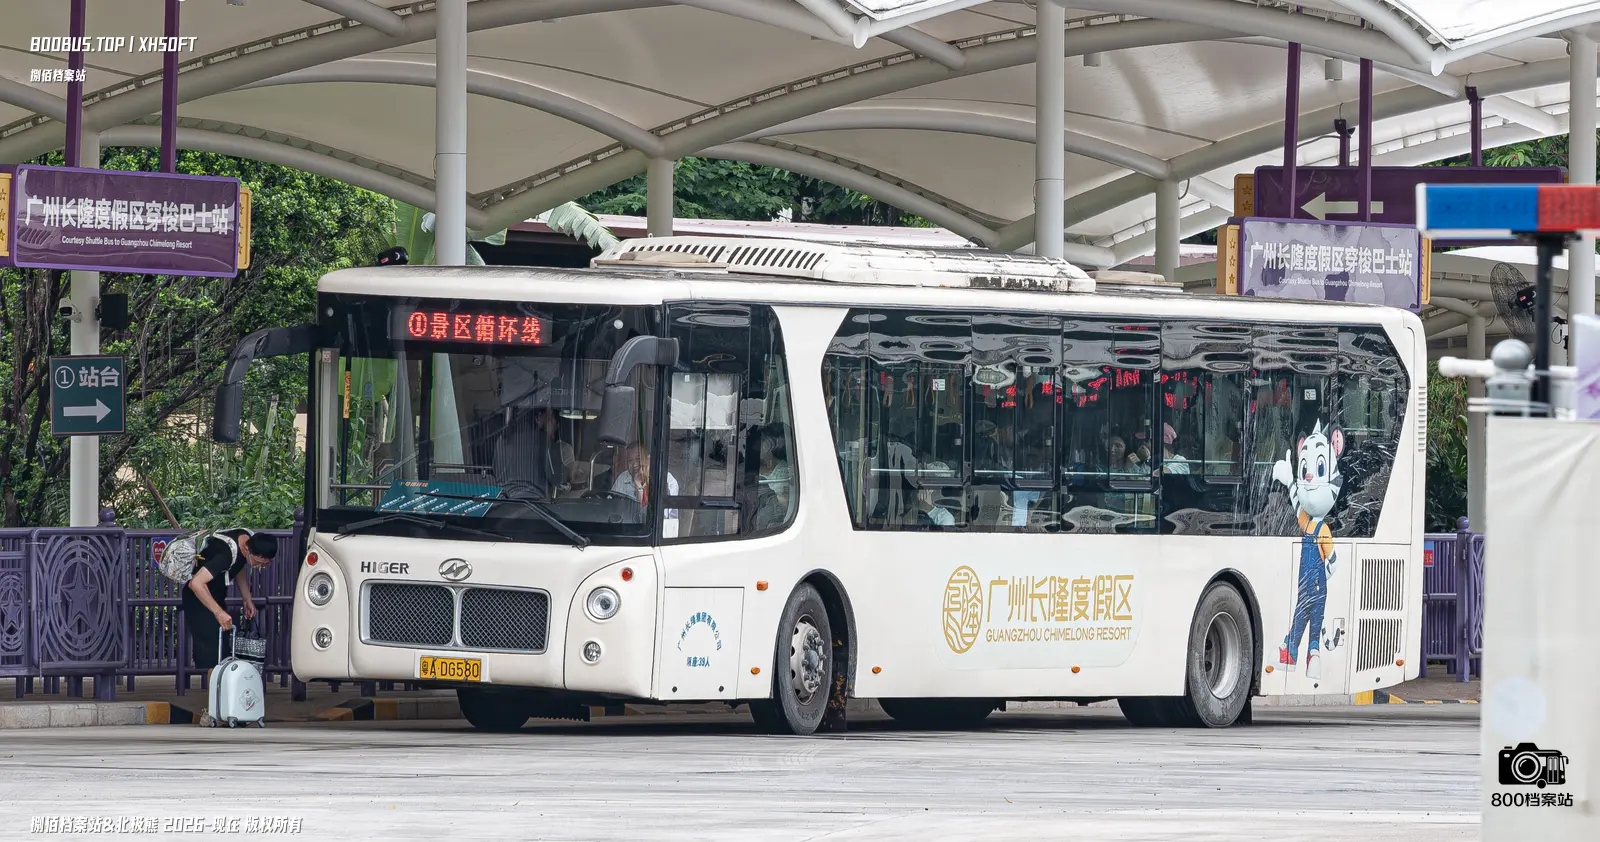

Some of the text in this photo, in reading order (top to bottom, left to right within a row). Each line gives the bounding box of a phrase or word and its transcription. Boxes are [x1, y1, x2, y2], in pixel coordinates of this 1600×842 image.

[24, 195, 229, 235] 广州长隆度假区穿梭巴士站
[62, 235, 193, 249] Courtesy Shuttle Bus to Guangzhou Chimelong Resort
[1249, 241, 1412, 276] 广州长隆度假区穿梭巴士站
[1325, 278, 1348, 288] Guangzhou
[360, 561, 410, 574] HIGER
[987, 575, 1134, 622] 广州长隆度假区
[986, 627, 1132, 642] GUANGZHOU CHIMELONG RESORT
